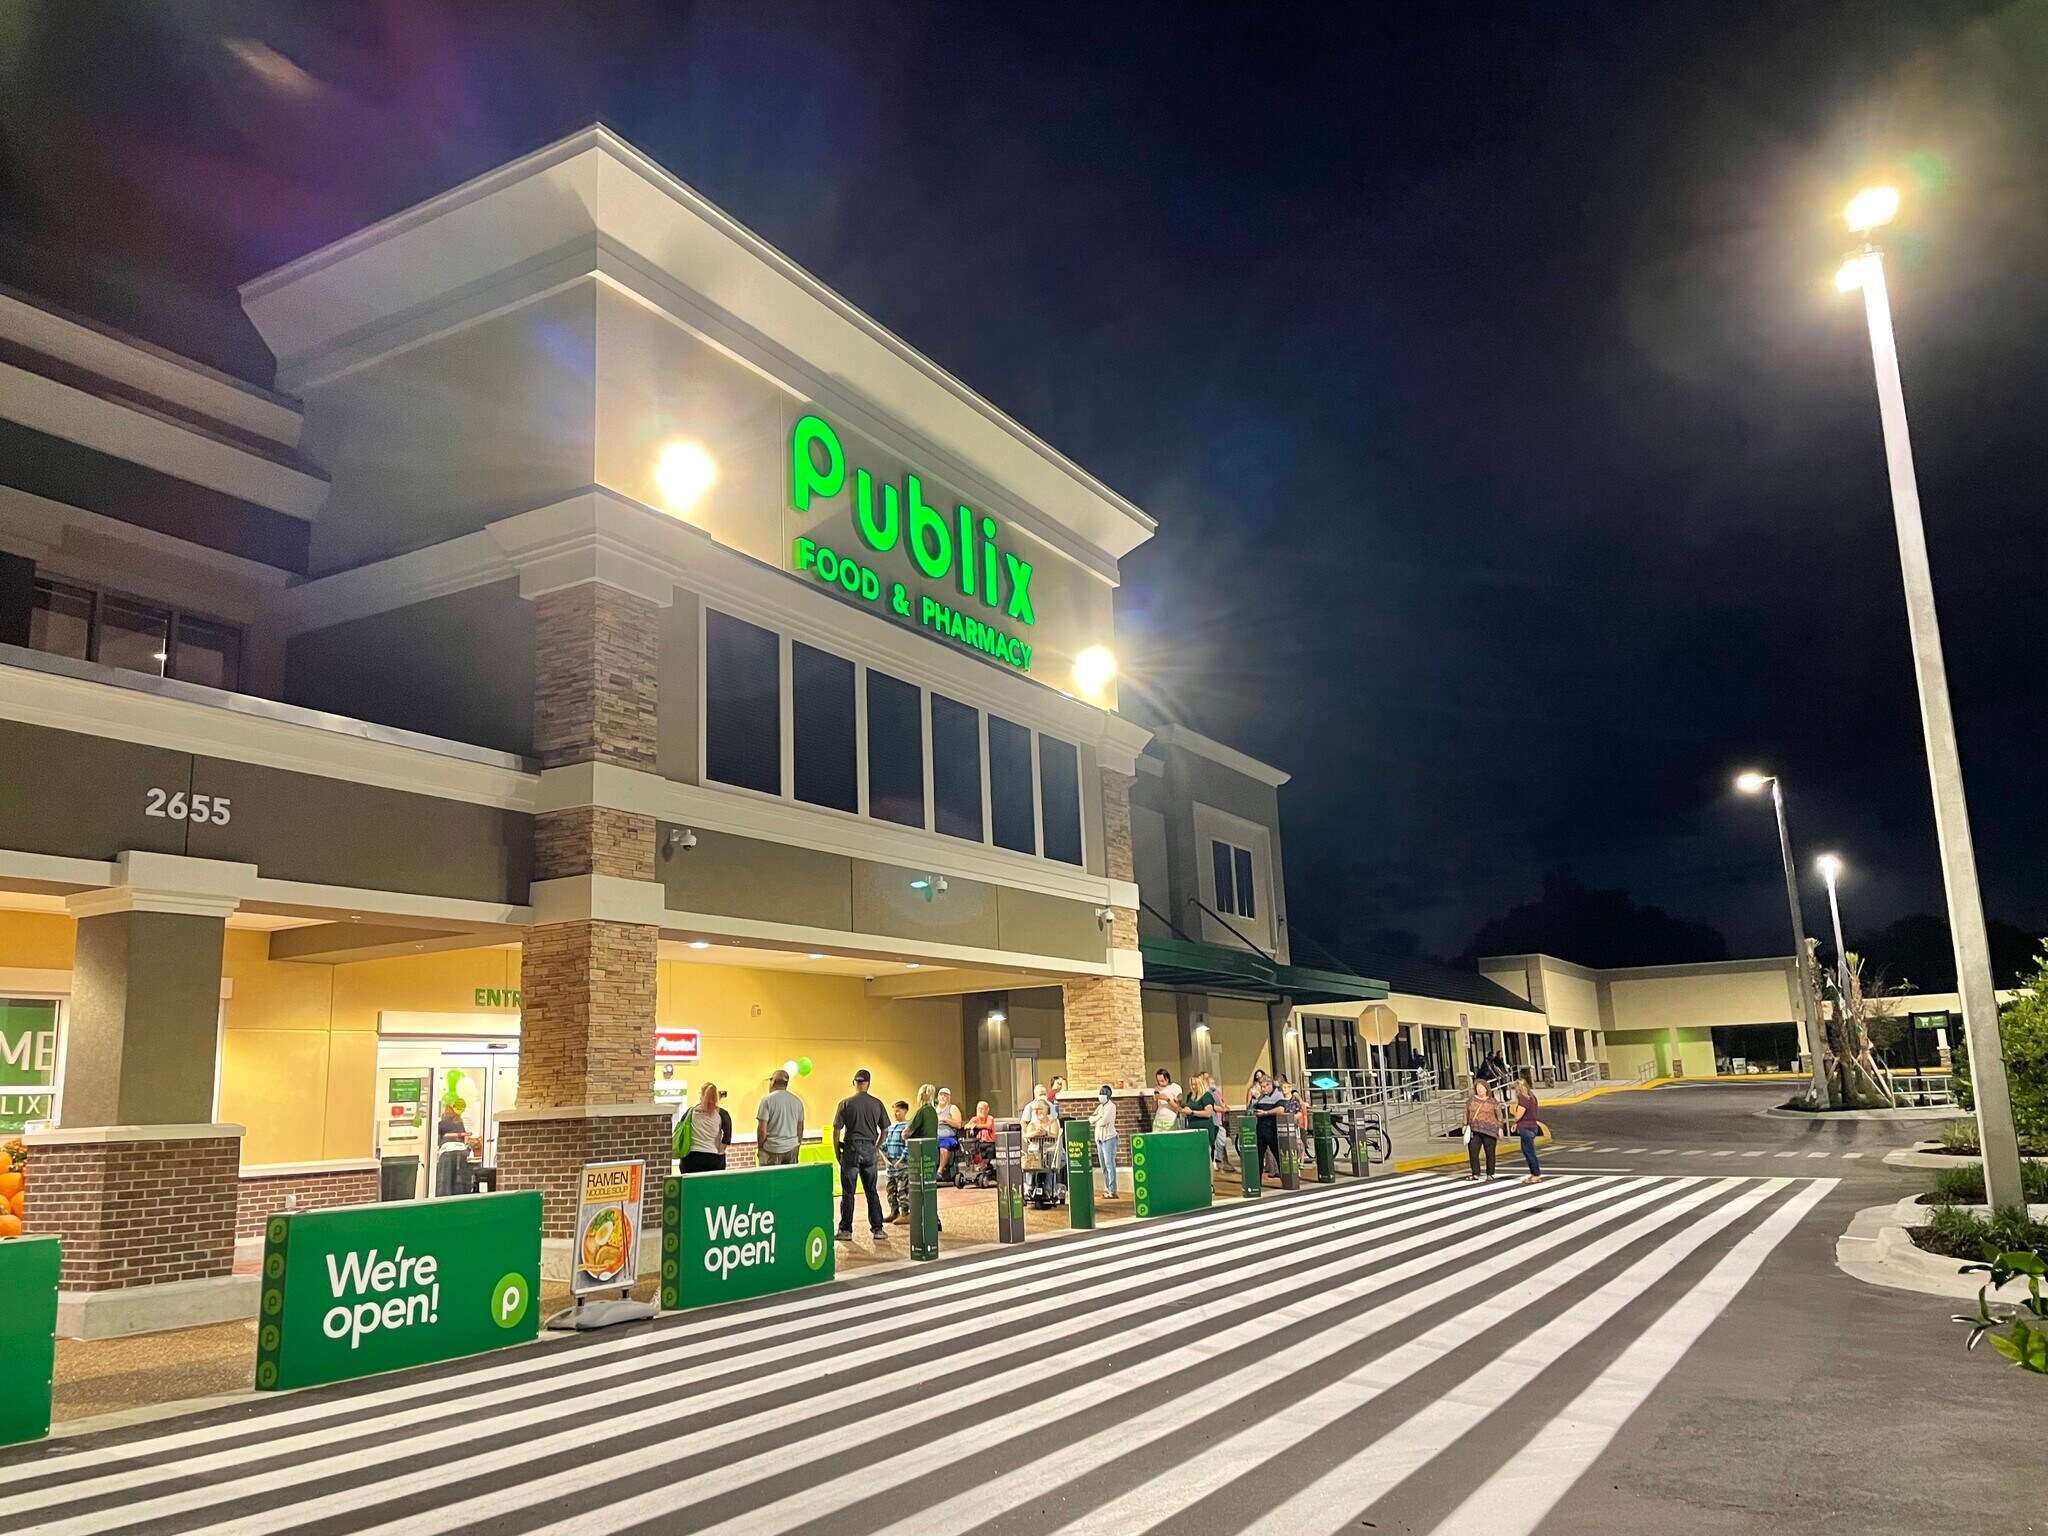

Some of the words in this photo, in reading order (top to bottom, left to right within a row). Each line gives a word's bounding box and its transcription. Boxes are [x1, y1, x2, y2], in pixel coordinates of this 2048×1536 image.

[793, 415, 1035, 625] Publix
[793, 537, 880, 601] FOOD
[892, 583, 910, 616] &
[922, 595, 1032, 672] PHARMACY
[145, 787, 231, 826] 2655
[587, 1171, 629, 1188] RAMEN
[704, 1203, 775, 1241] We're
[325, 1246, 438, 1298] We're
[704, 1233, 776, 1281] open!
[322, 1283, 440, 1350] open!
